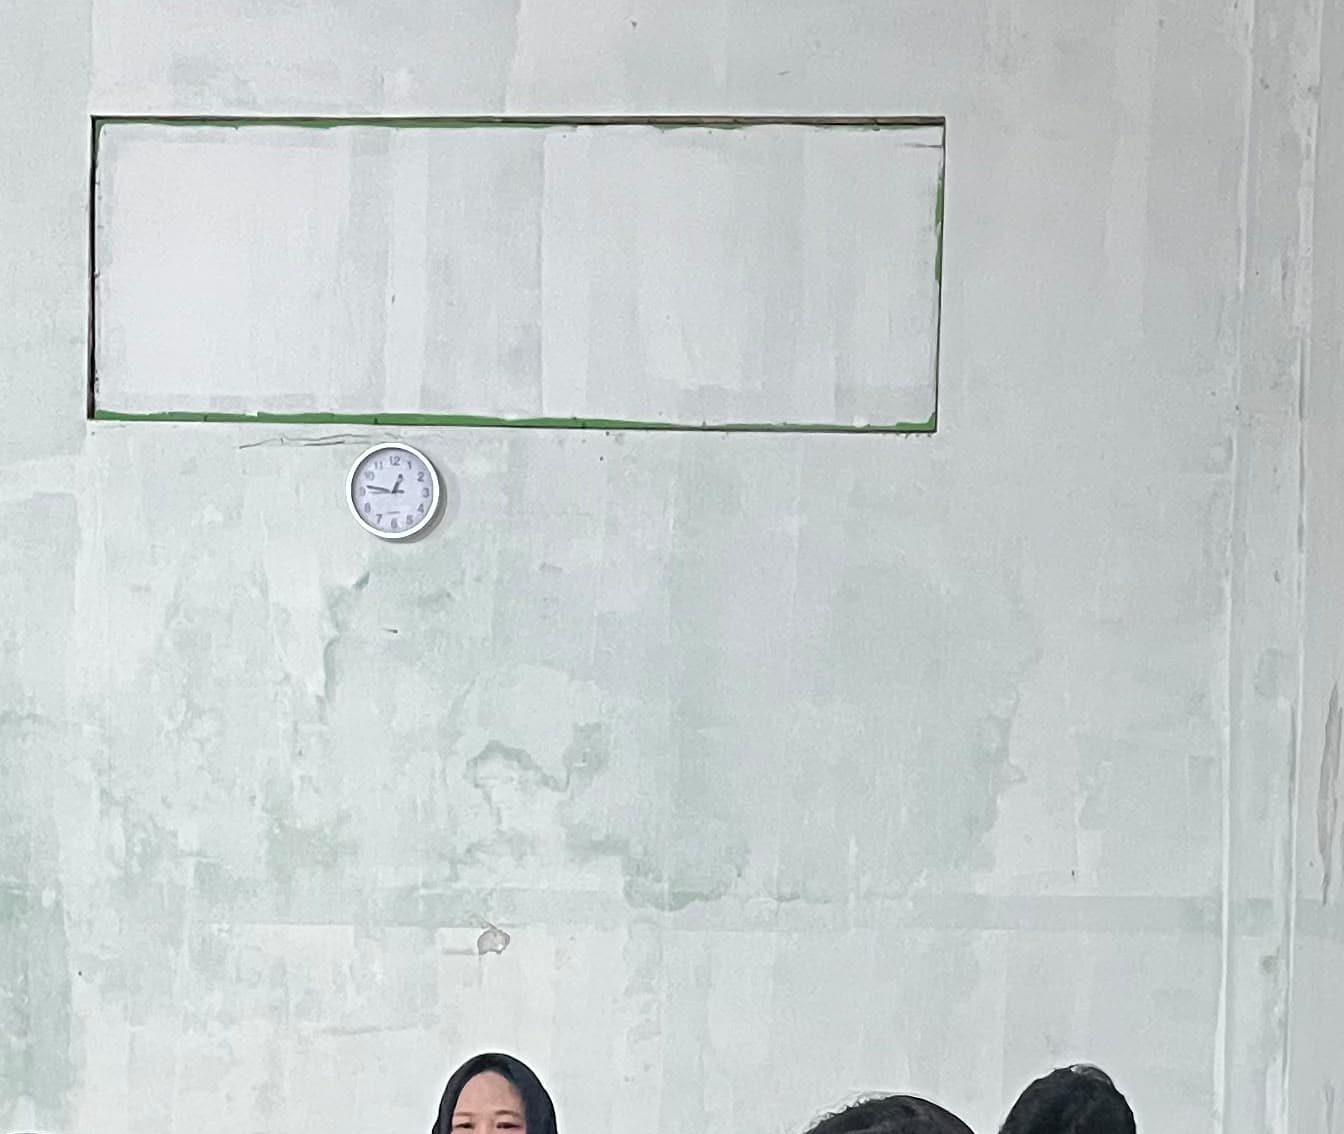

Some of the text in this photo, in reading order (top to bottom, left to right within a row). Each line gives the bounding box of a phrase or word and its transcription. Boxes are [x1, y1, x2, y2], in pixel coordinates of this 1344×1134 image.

[374, 461, 383, 469] 11
[389, 456, 400, 466] 12
[365, 471, 374, 481] 10
[417, 472, 424, 482] 2
[422, 488, 429, 497] 3
[417, 504, 424, 513] 4
[376, 514, 383, 524] 7
[406, 515, 413, 524] 5
